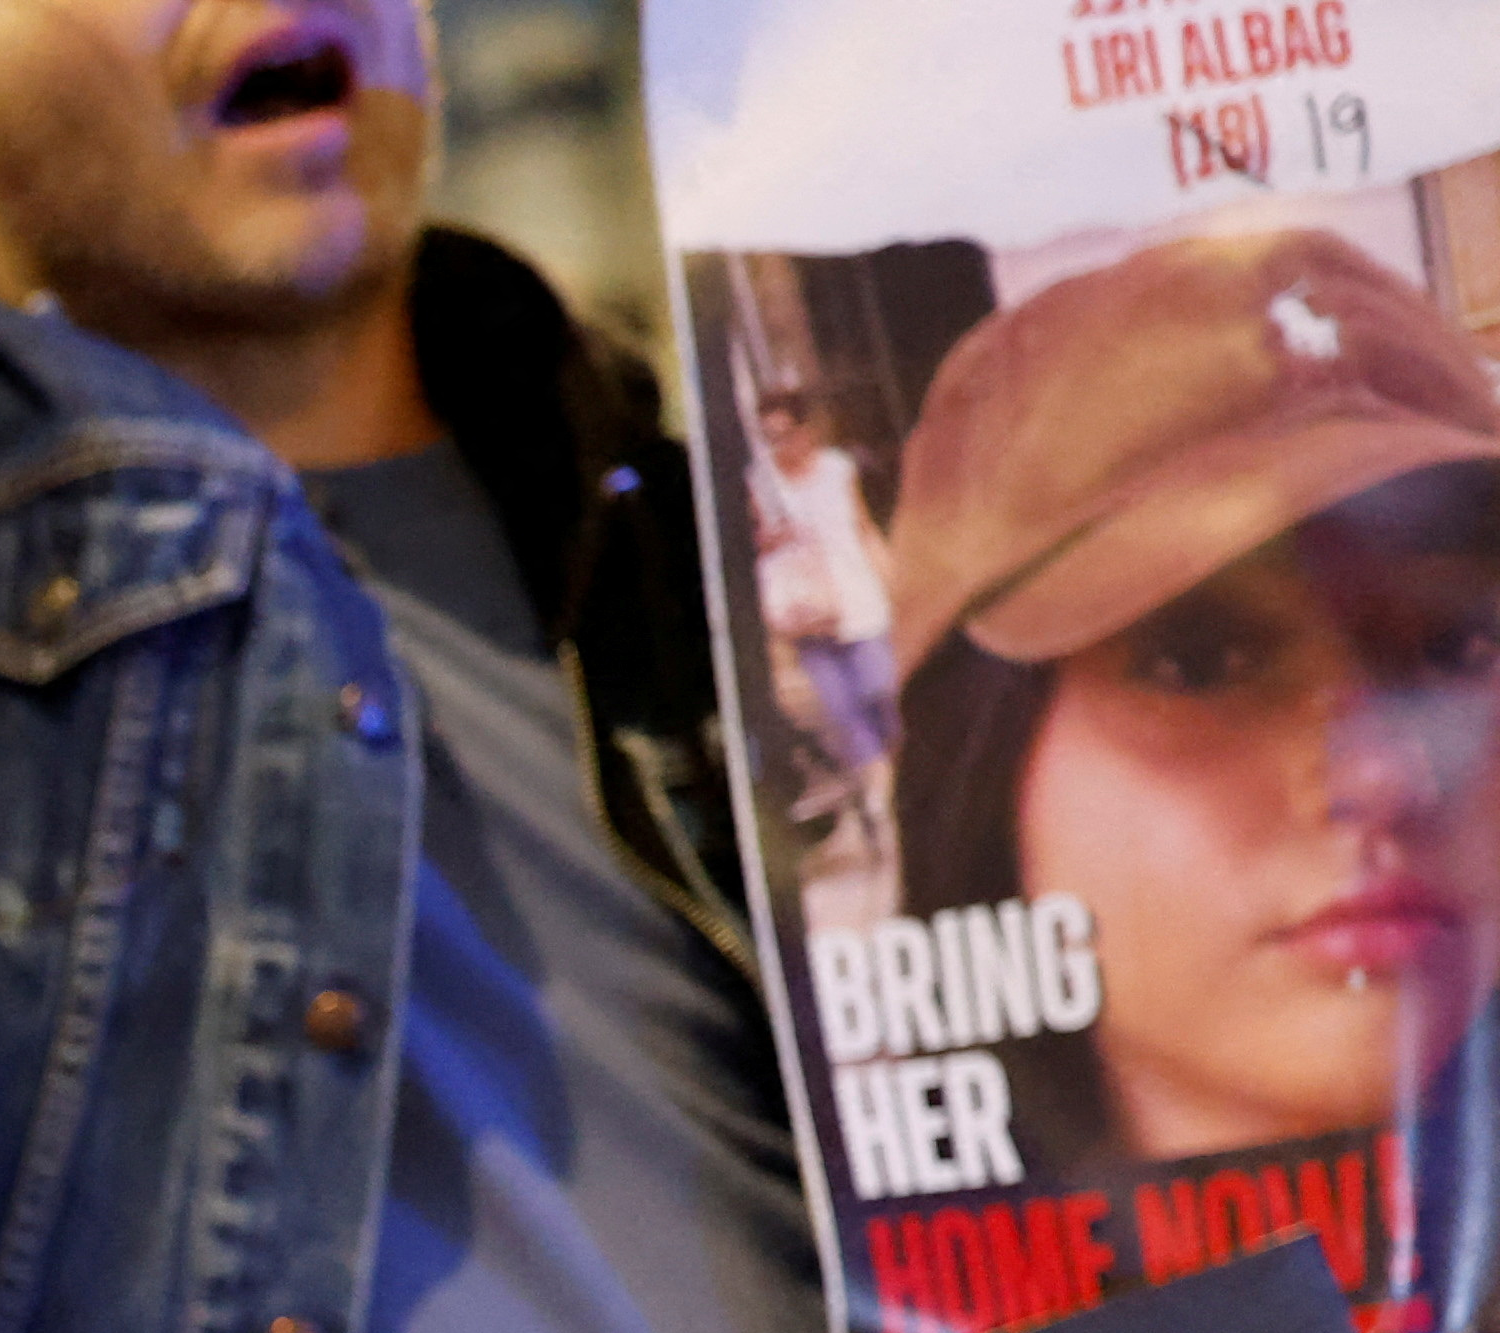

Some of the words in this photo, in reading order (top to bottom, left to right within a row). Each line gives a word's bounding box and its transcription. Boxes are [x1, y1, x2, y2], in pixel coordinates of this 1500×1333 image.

[1062, 24, 1164, 109] LIRI
[1180, 0, 1353, 88] ALBAG
[1303, 91, 1371, 174] 19
[807, 891, 1102, 1064] BRING
[833, 1049, 1026, 1201] HER
